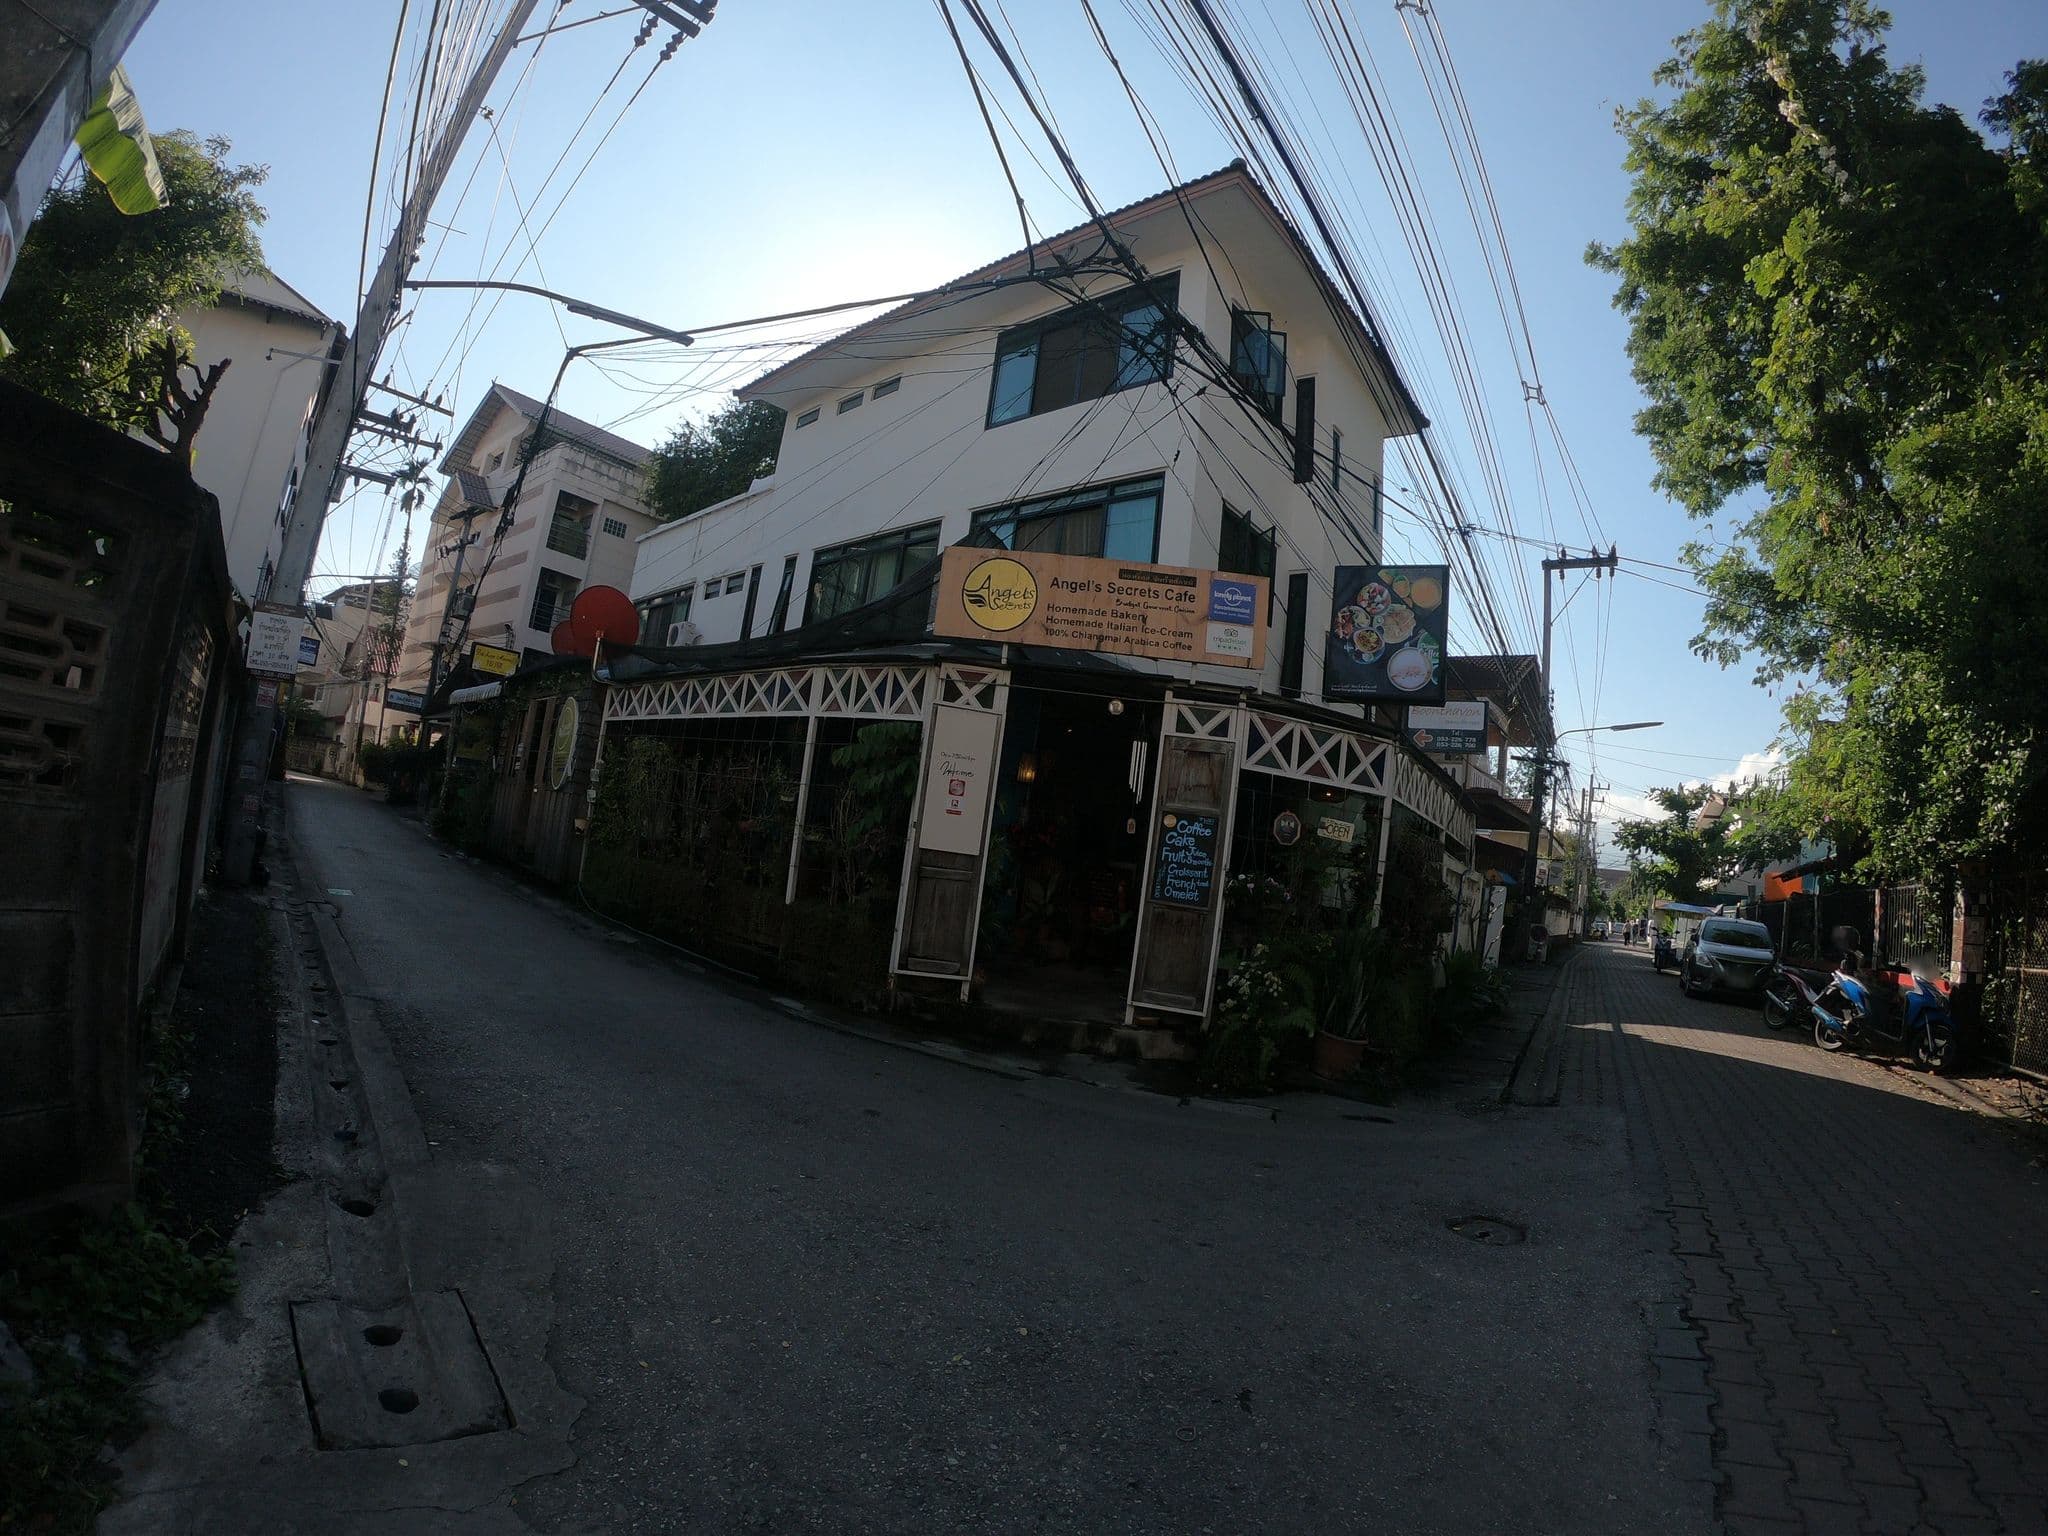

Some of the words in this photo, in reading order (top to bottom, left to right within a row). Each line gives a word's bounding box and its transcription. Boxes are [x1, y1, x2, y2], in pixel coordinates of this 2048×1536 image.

[1049, 576, 1102, 593] Angel's
[1107, 582, 1160, 599] Secrets
[1164, 588, 1196, 603] Cafe
[1214, 590, 1232, 601] lonely
[1233, 593, 1252, 602] planet
[1046, 603, 1108, 617] Homemade
[1110, 609, 1148, 624] Bakery
[1045, 615, 1104, 629] Homemade
[1107, 621, 1138, 633] Italian
[1141, 623, 1193, 639] Ice-Cream
[1045, 628, 1069, 637] 100%
[1071, 630, 1121, 643] Chiangmai
[1123, 636, 1160, 648] Arabica
[1162, 639, 1193, 651] Coffee
[1177, 820, 1212, 836] Coffee
[1165, 831, 1195, 847] Cake
[1161, 847, 1186, 864] Fruit
[1166, 874, 1196, 890] French
[1164, 886, 1201, 902] Omelet
